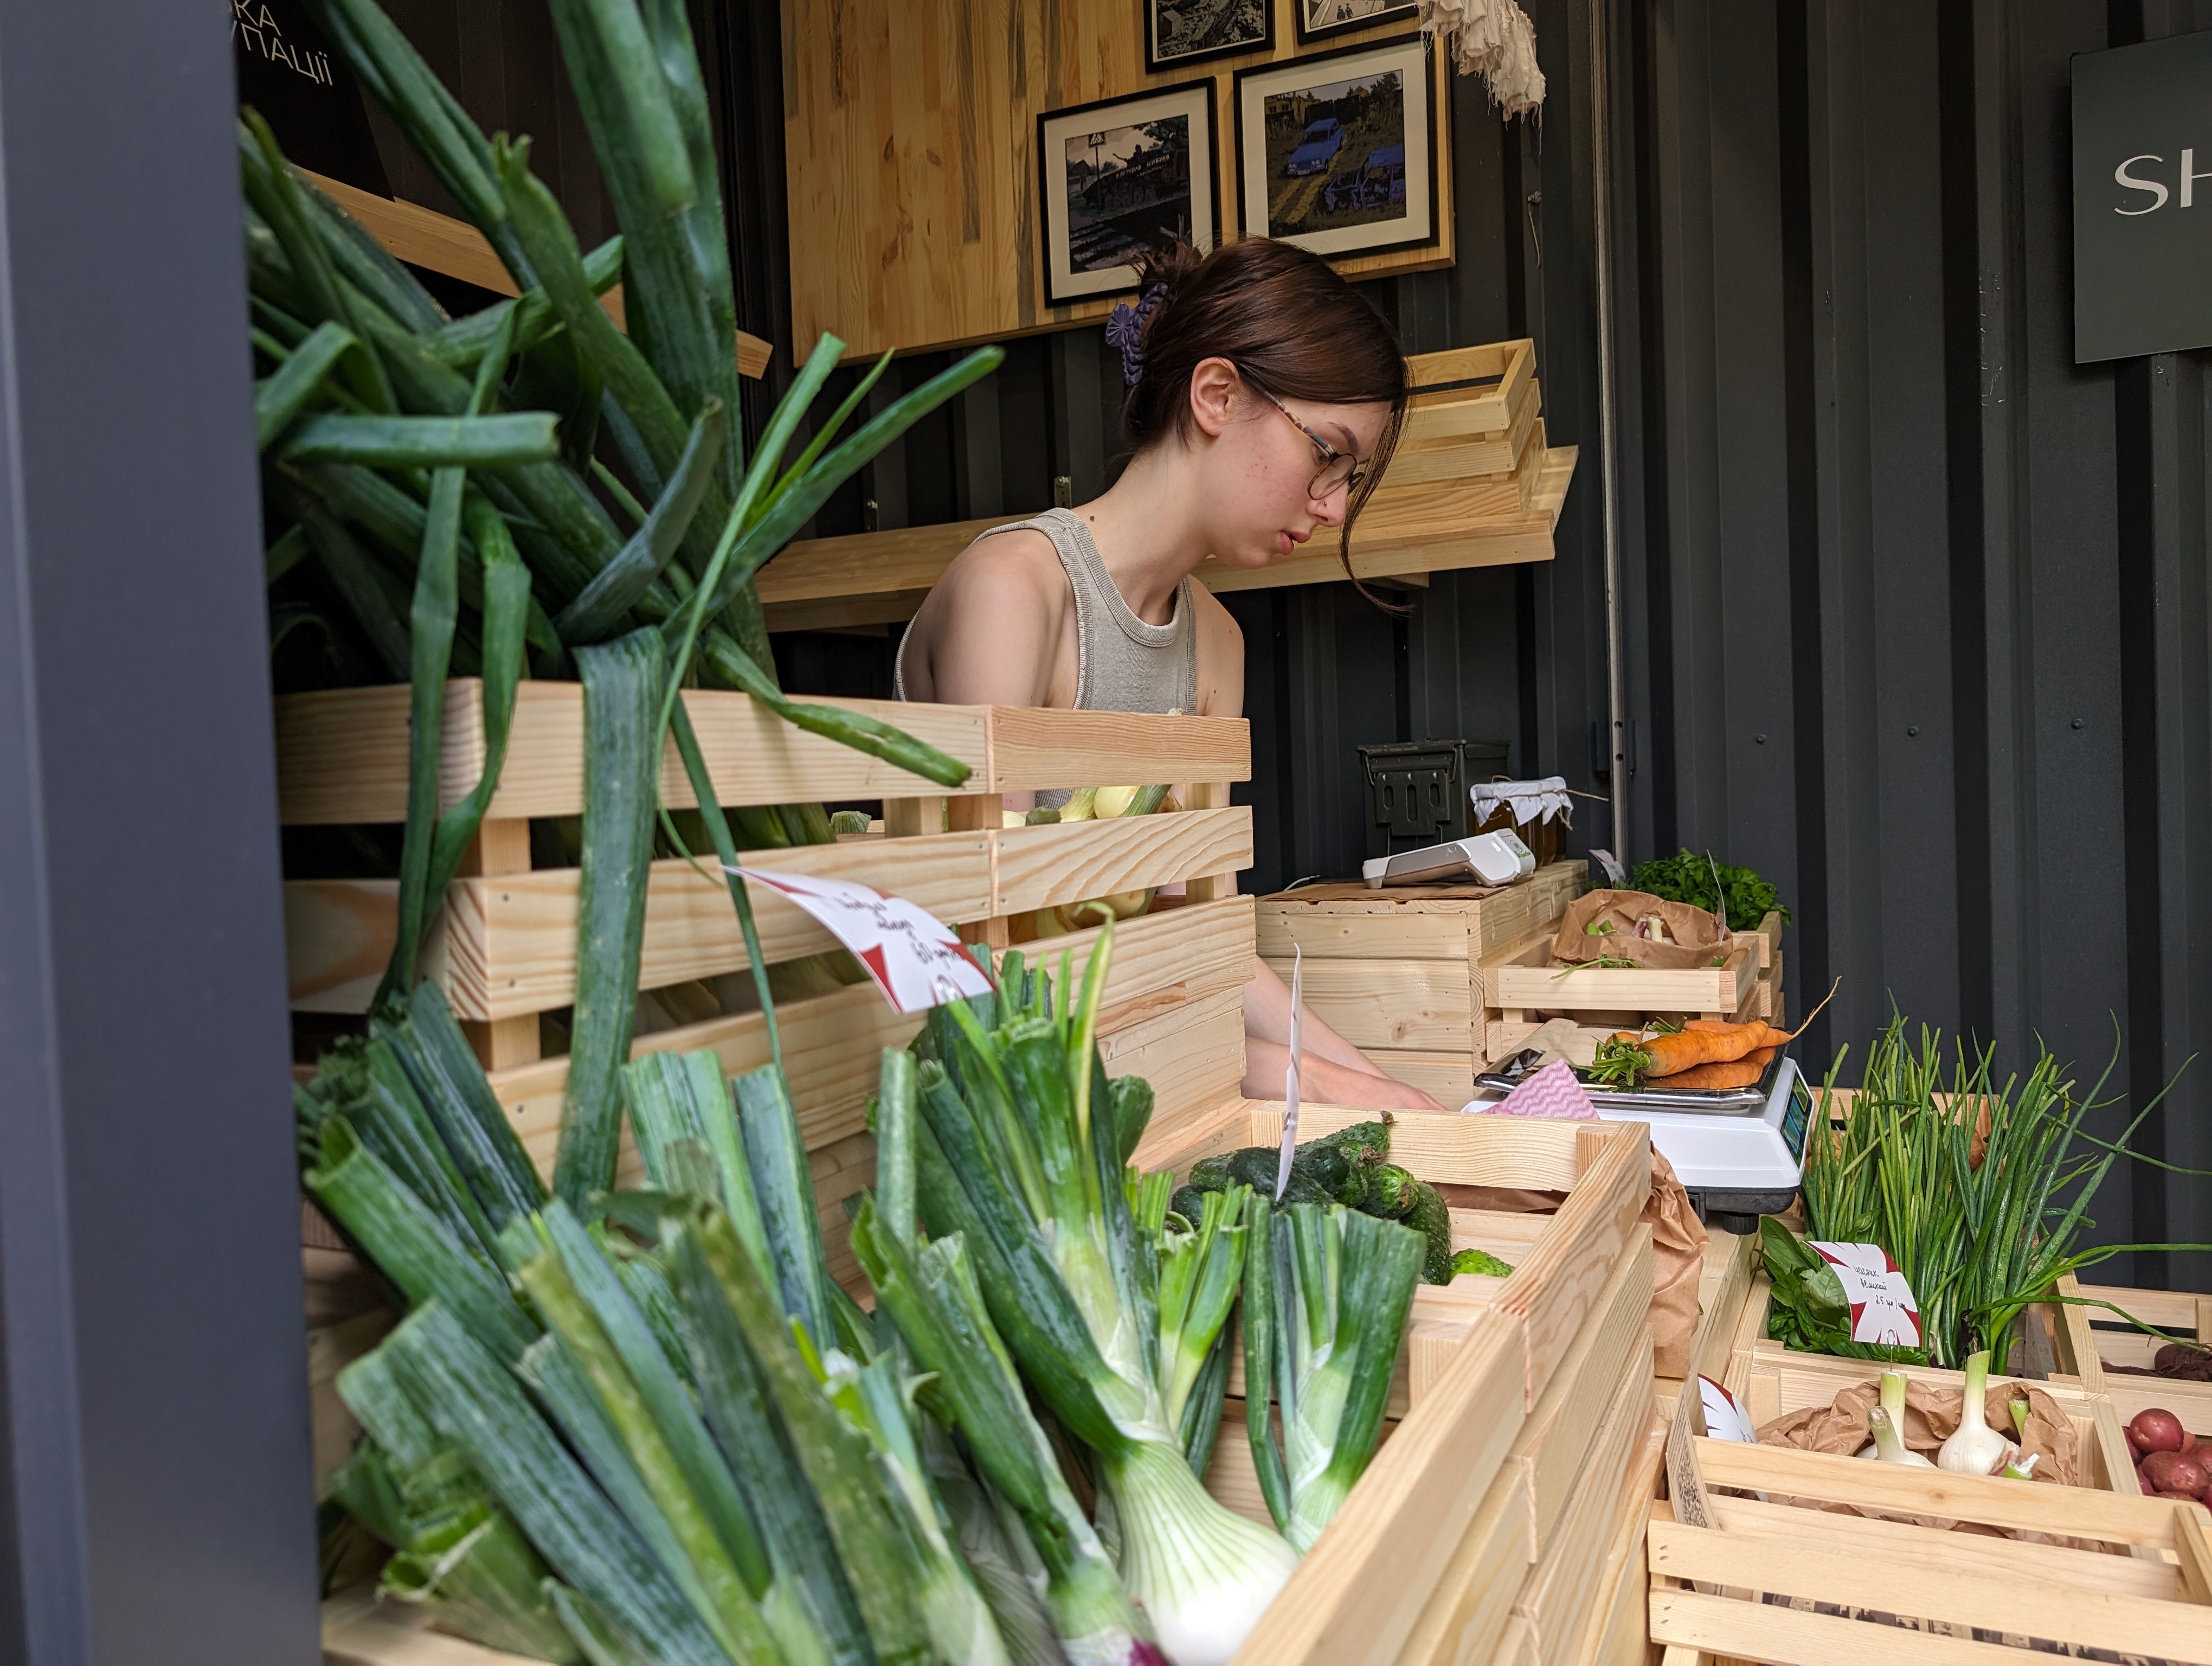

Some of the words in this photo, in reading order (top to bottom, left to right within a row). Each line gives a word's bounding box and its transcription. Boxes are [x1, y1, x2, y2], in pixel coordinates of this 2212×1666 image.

[233, 0, 282, 37] КА
[910, 941, 934, 965] 60
[1875, 1295, 1884, 1305] 25
